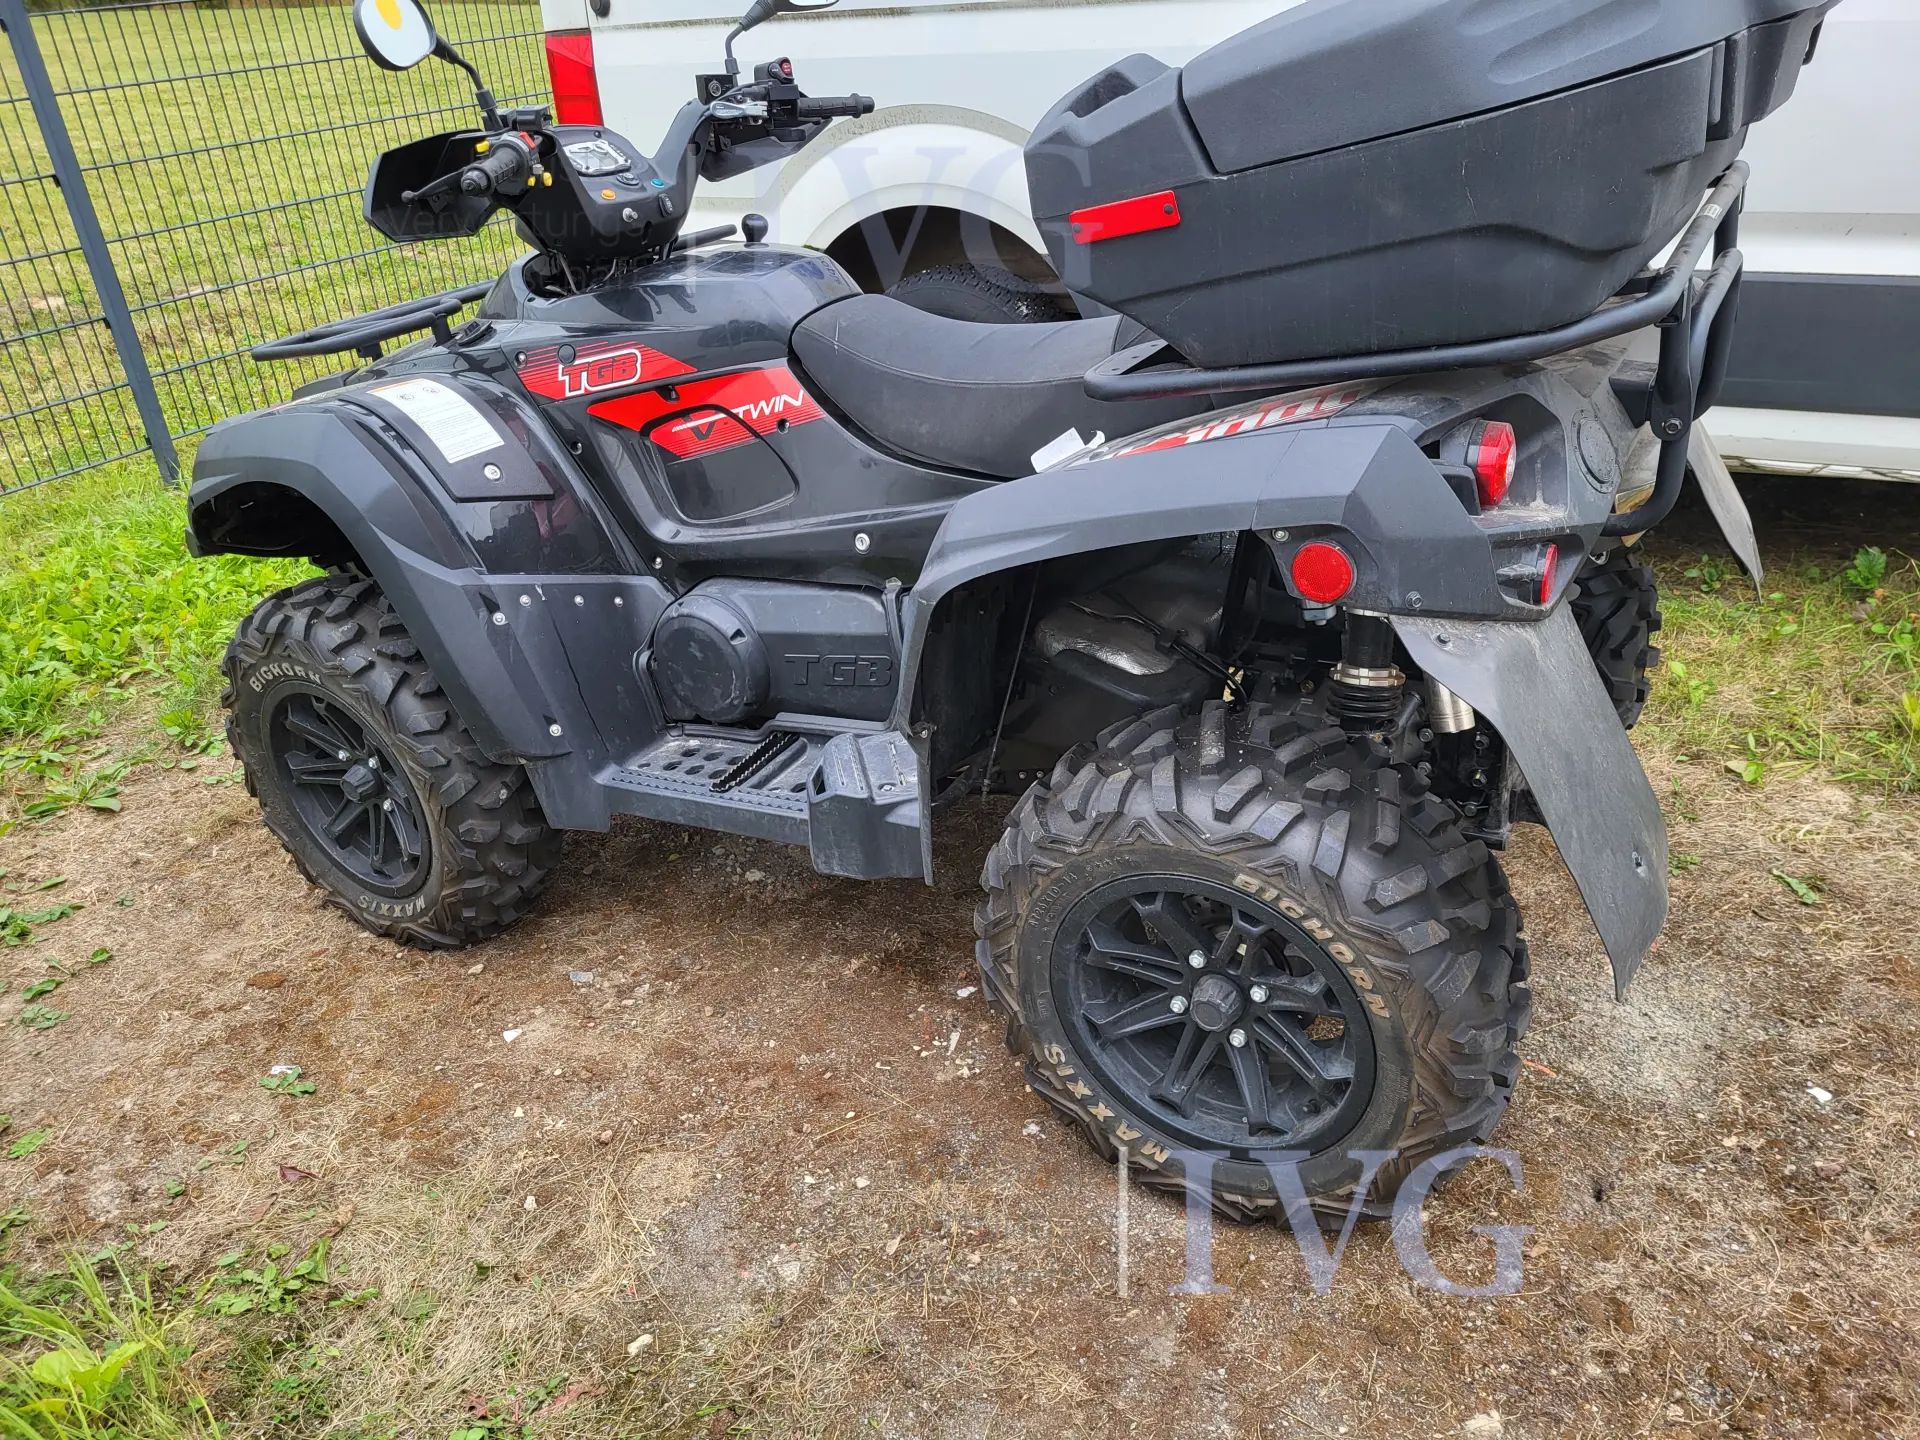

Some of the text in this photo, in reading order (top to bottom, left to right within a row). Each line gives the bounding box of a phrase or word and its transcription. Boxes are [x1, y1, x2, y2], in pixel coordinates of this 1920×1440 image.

[558, 349, 642, 397] TGB
[249, 662, 321, 693] BIGHORN
[784, 653, 893, 687] TGB
[357, 894, 426, 917] MAXXIS
[1232, 873, 1390, 1018] BIGHORN
[1044, 1043, 1174, 1164] MAXXIS
